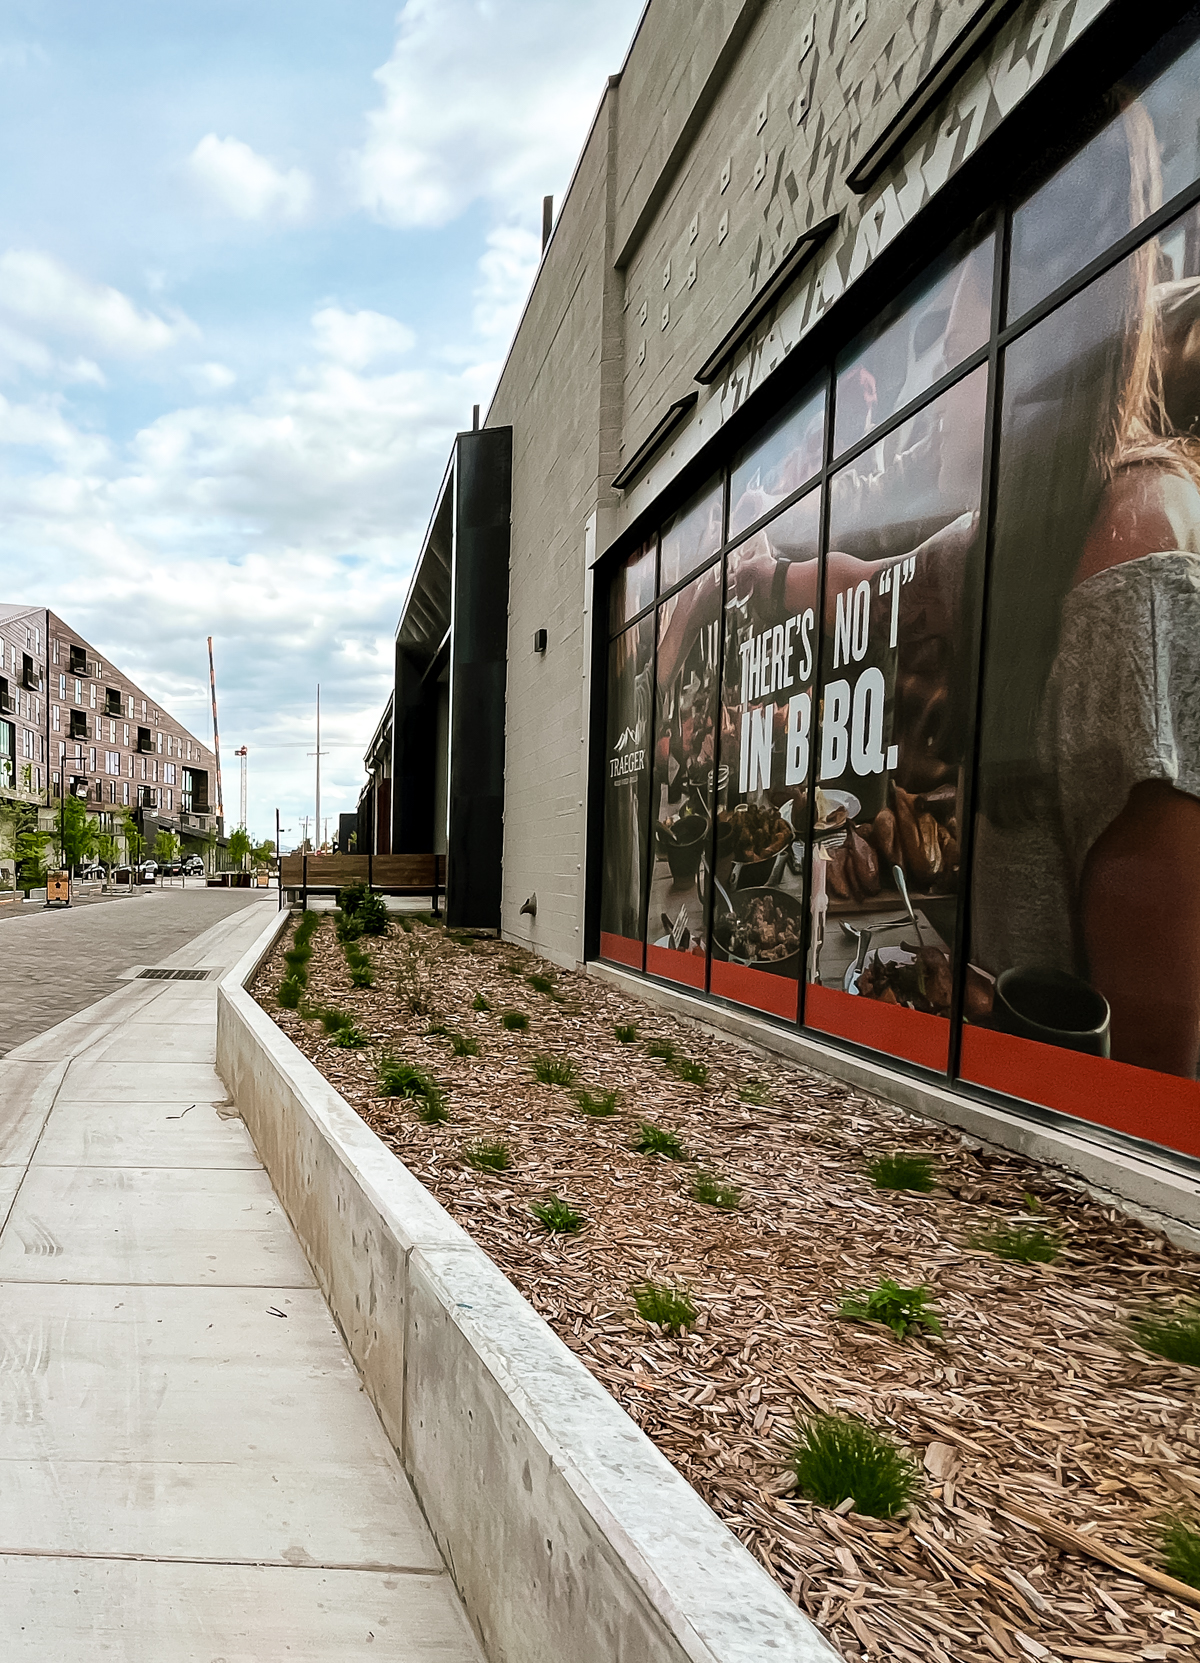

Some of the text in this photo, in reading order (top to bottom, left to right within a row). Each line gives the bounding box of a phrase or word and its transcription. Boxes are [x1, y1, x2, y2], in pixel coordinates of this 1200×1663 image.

[739, 607, 814, 704] THERE'S
[833, 579, 870, 669] NO
[609, 749, 646, 778] TRAEGER
[738, 703, 774, 793] IN
